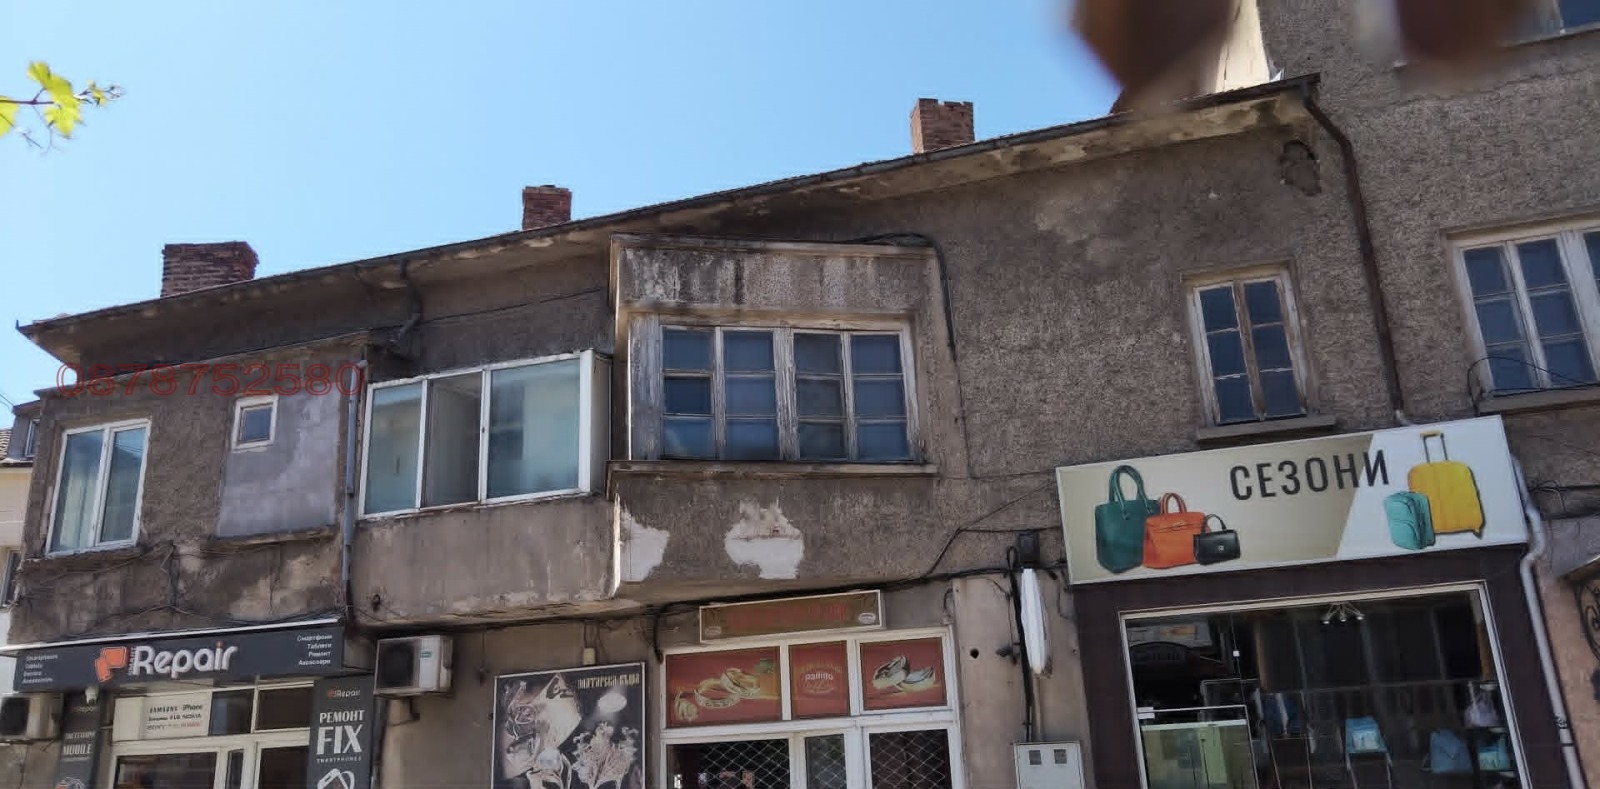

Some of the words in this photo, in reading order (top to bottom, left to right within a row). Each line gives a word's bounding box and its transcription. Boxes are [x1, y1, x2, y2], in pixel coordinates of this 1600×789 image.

[1229, 449, 1390, 501] СЕЗОНИ
[132, 640, 238, 679] Repair
[319, 710, 365, 724] РЕМОНТ
[63, 744, 93, 755] MOBILE
[316, 724, 364, 755] FIX
